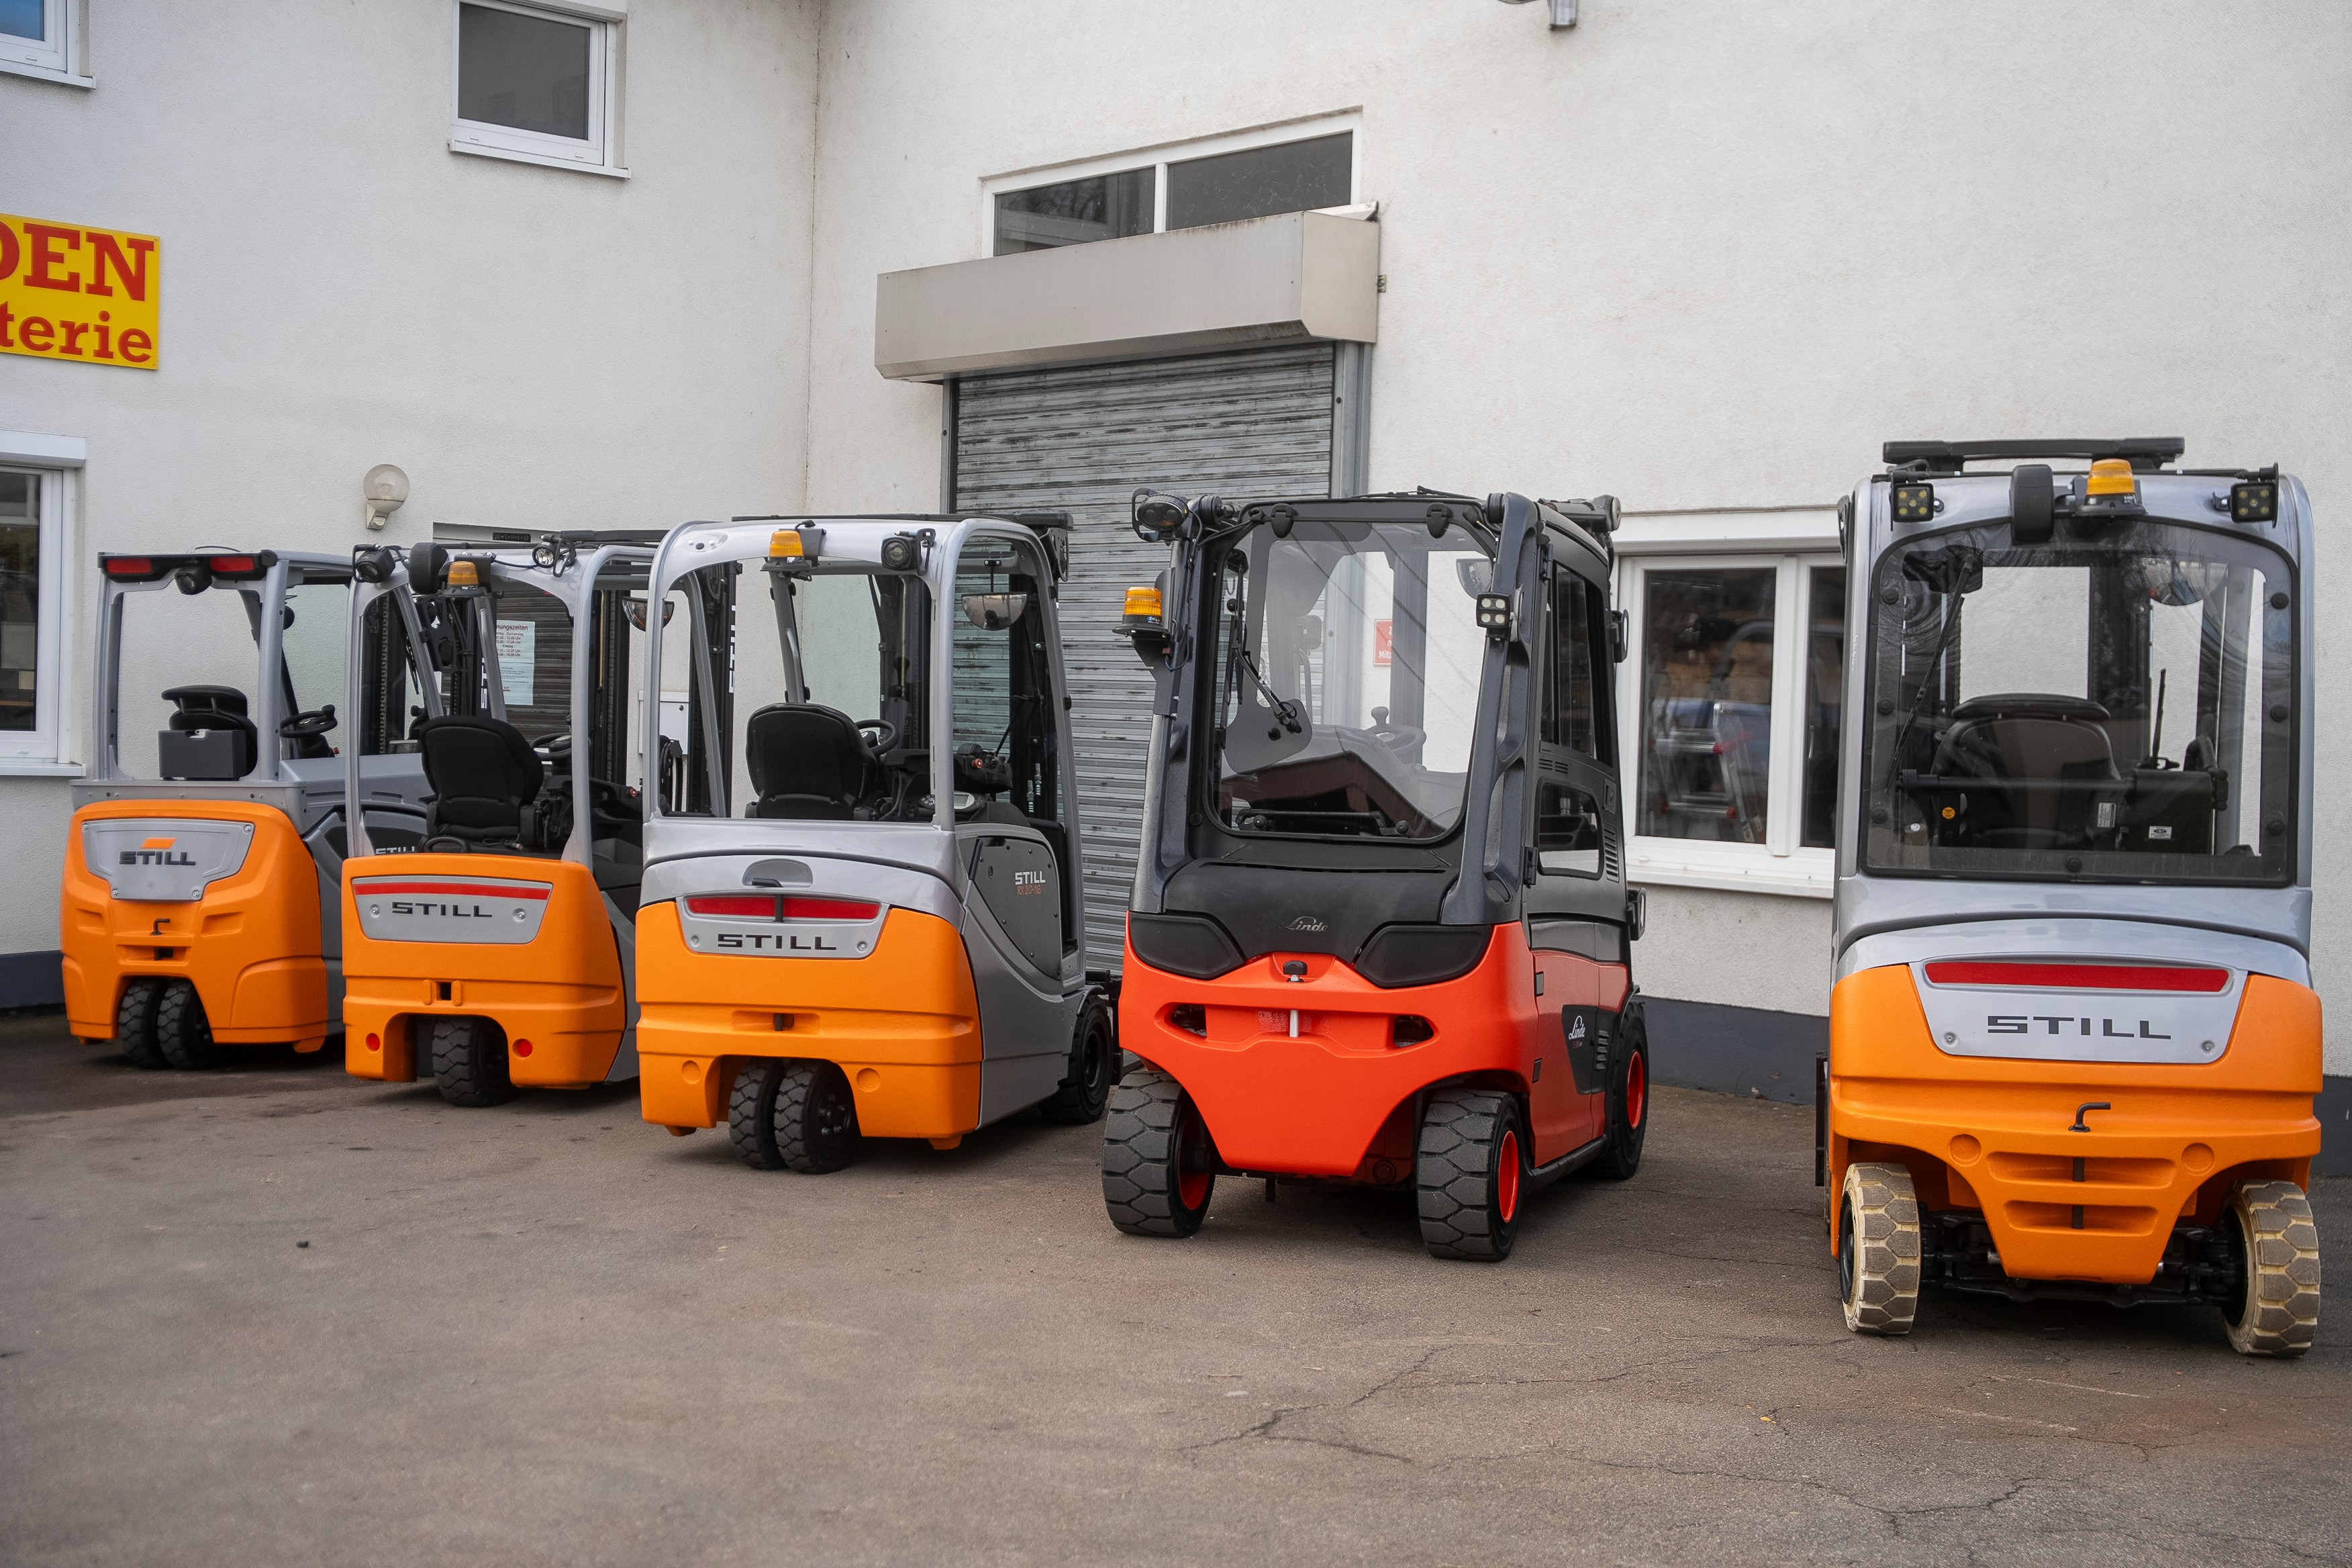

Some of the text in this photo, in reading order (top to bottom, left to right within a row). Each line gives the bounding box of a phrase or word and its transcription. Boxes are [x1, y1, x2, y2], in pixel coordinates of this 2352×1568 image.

[119, 850, 196, 865] STILL
[1015, 871, 1046, 885] STILL
[392, 901, 492, 918] STILL
[1277, 916, 1328, 932] Linde
[718, 934, 836, 950] STILL
[1568, 1015, 1585, 1040] Linde
[1988, 1016, 2171, 1040] STILL
